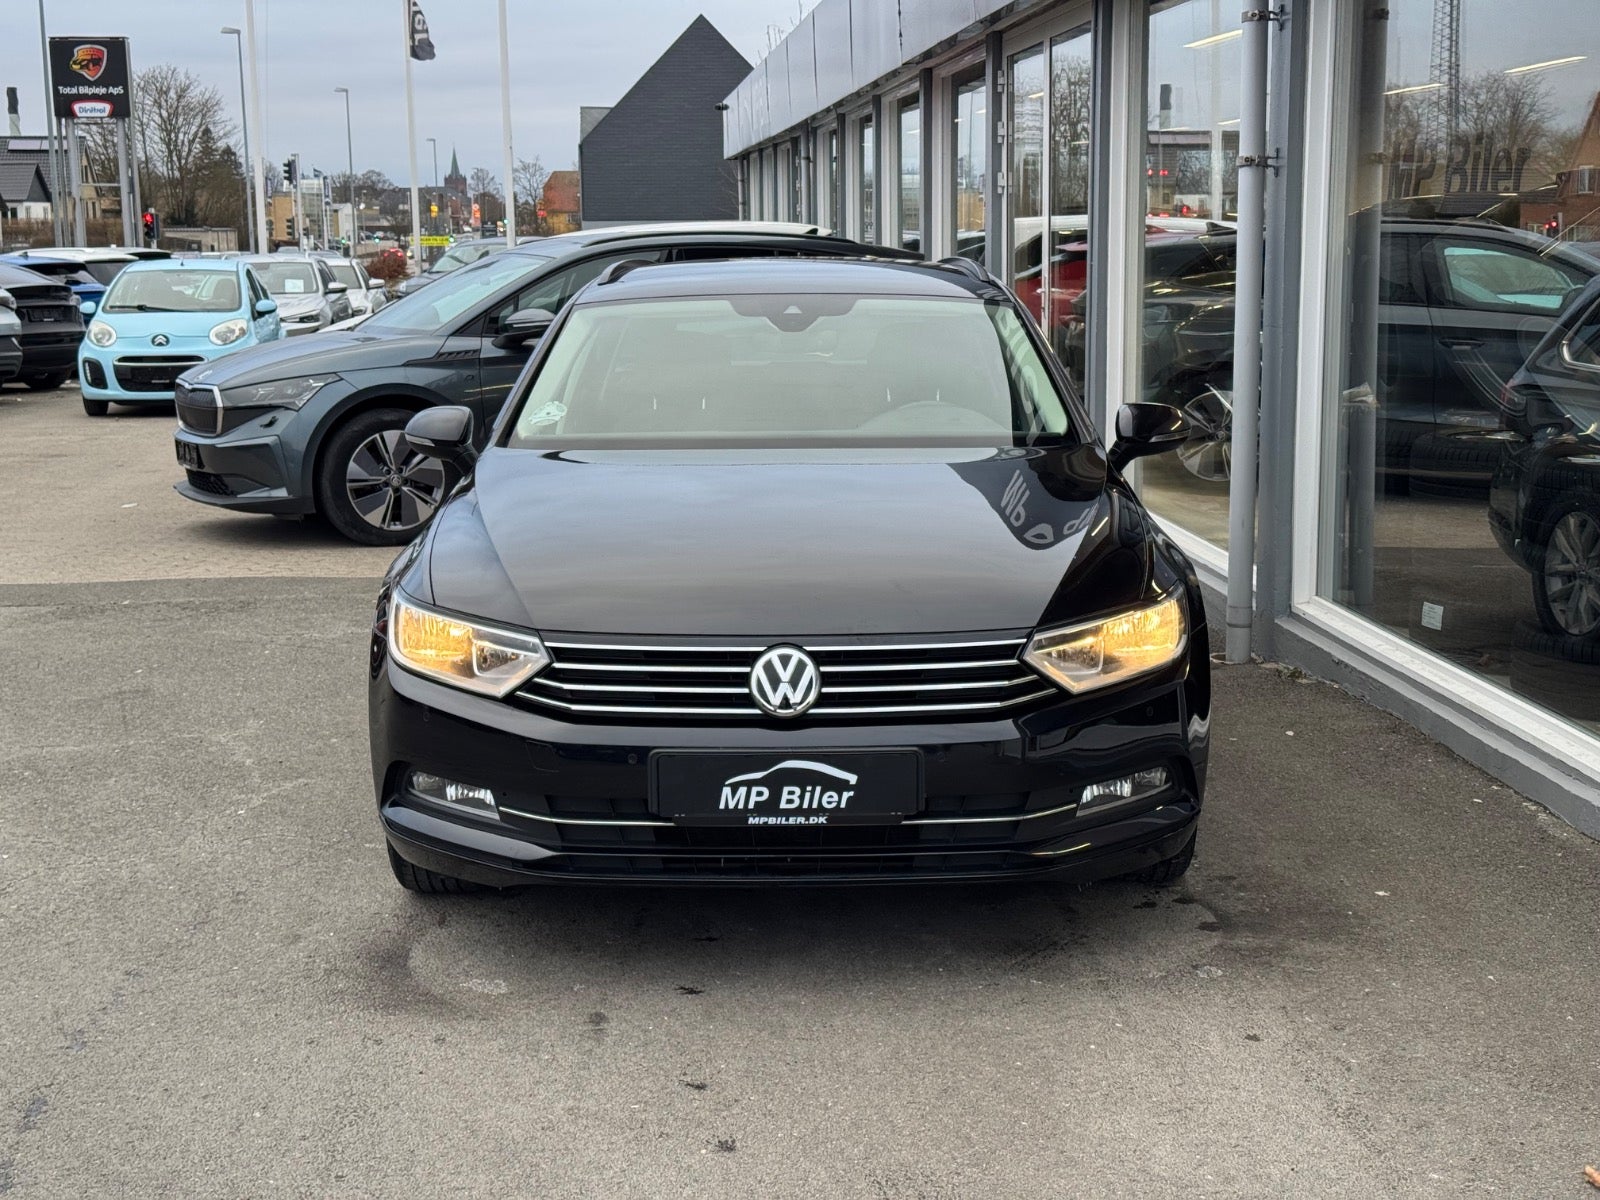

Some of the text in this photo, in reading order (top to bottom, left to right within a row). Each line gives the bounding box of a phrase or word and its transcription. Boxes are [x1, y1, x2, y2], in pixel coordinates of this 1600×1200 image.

[58, 85, 124, 96] Total Bilpleje ApS
[78, 106, 106, 114] Dinitrol
[1444, 131, 1532, 193] Biler
[719, 785, 855, 809] MP Biler
[747, 816, 829, 825] MPBILER.DK
